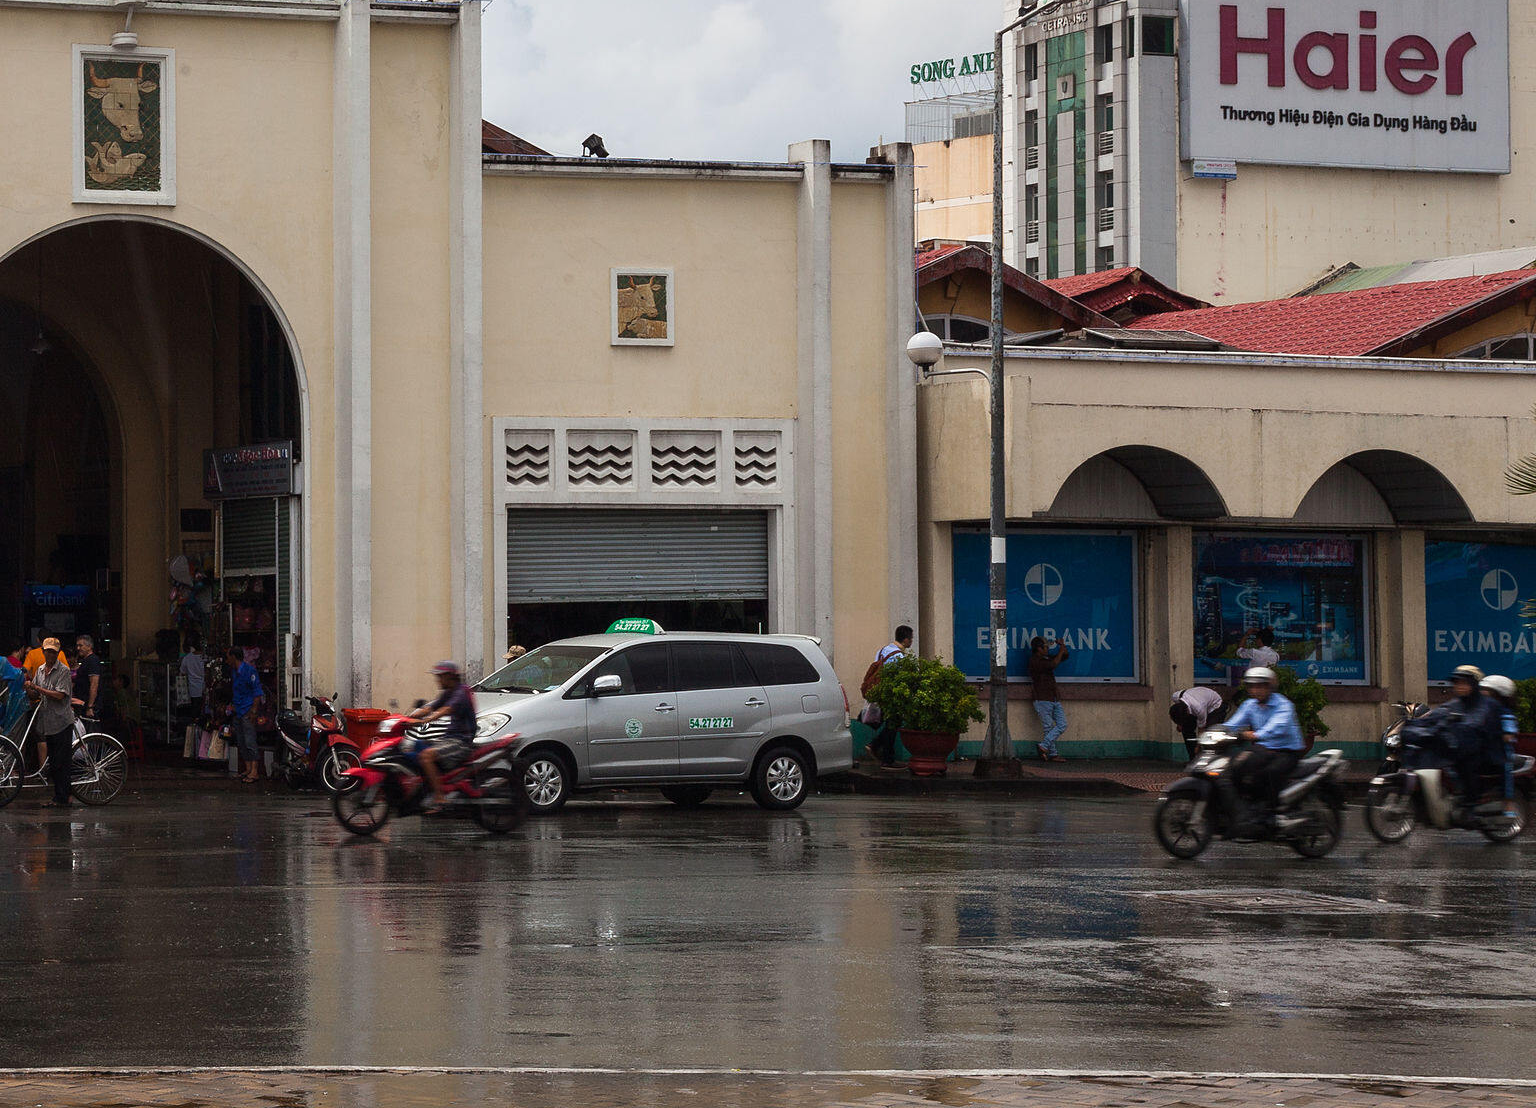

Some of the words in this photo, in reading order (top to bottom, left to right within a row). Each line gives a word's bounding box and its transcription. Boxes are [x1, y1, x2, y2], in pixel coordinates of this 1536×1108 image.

[1220, 5, 1477, 95] Haier
[910, 58, 955, 84] SONG
[1221, 105, 1275, 126] Thương
[1279, 109, 1309, 126] Hiệu
[1313, 110, 1344, 129] Điện
[1347, 112, 1370, 128] Gia
[1373, 113, 1409, 132] Dụng
[1413, 115, 1448, 134] Hàng
[1450, 114, 1478, 133] Đầu
[36, 594, 86, 606] citibank
[976, 626, 1112, 651] EIMBANK
[1322, 666, 1358, 674] EXIMBANK
[689, 718, 712, 729] 54.27
[713, 718, 722, 728] 27
[723, 717, 733, 728] 27
